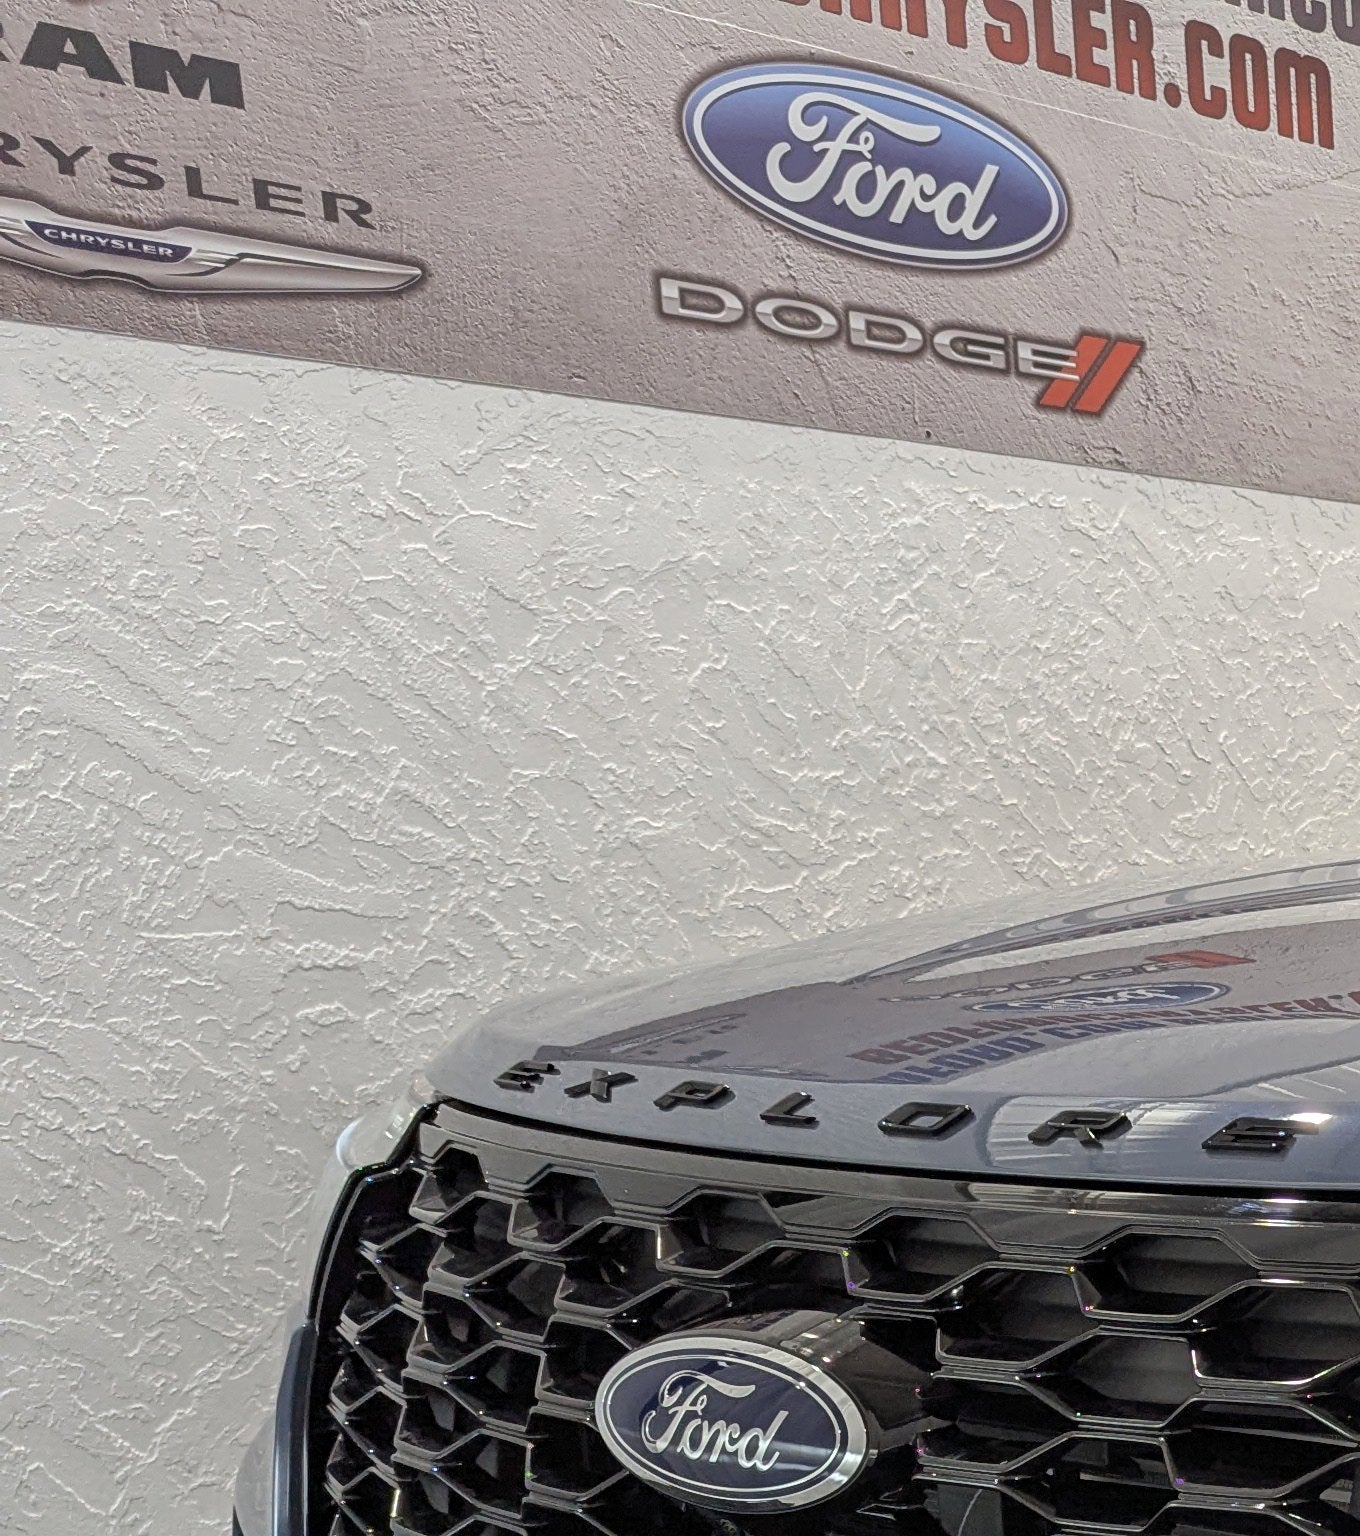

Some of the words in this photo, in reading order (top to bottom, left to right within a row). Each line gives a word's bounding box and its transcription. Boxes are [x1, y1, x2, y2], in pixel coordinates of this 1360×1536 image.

[0, 21, 246, 110] AM
[778, 0, 1334, 150] SLER.COM
[766, 92, 999, 241] Ford
[43, 228, 175, 258] CHRYSLER
[659, 277, 1080, 381] DODGE
[642, 1370, 790, 1471] Ford
